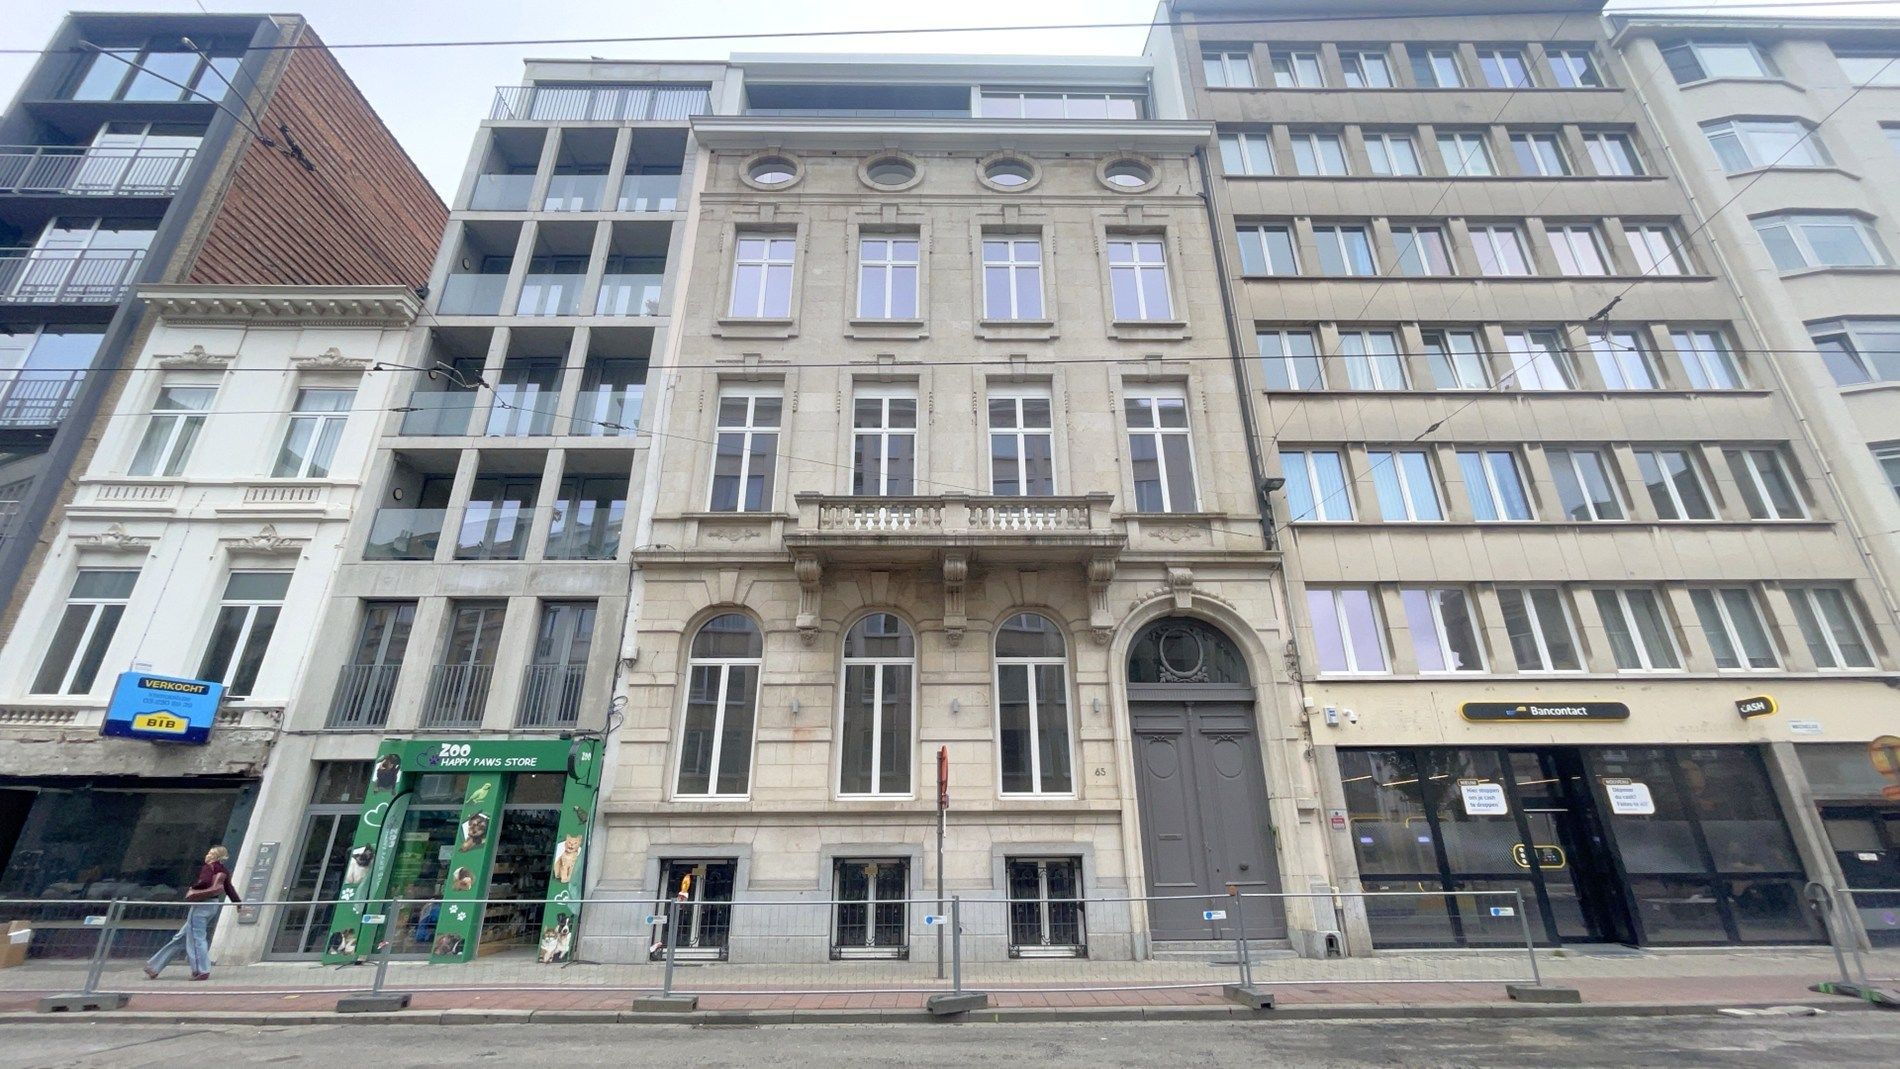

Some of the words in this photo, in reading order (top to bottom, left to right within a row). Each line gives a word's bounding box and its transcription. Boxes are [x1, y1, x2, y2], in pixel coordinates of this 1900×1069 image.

[145, 680, 204, 693] VERKOCHT
[1530, 706, 1588, 716] Bancontact
[1740, 701, 1766, 713] CASH
[146, 718, 176, 729] BIB
[439, 743, 471, 757] ZOO
[440, 757, 472, 767] HAPPY
[473, 757, 502, 767] PAWS
[504, 757, 538, 767] STORE
[1095, 767, 1106, 776] 65
